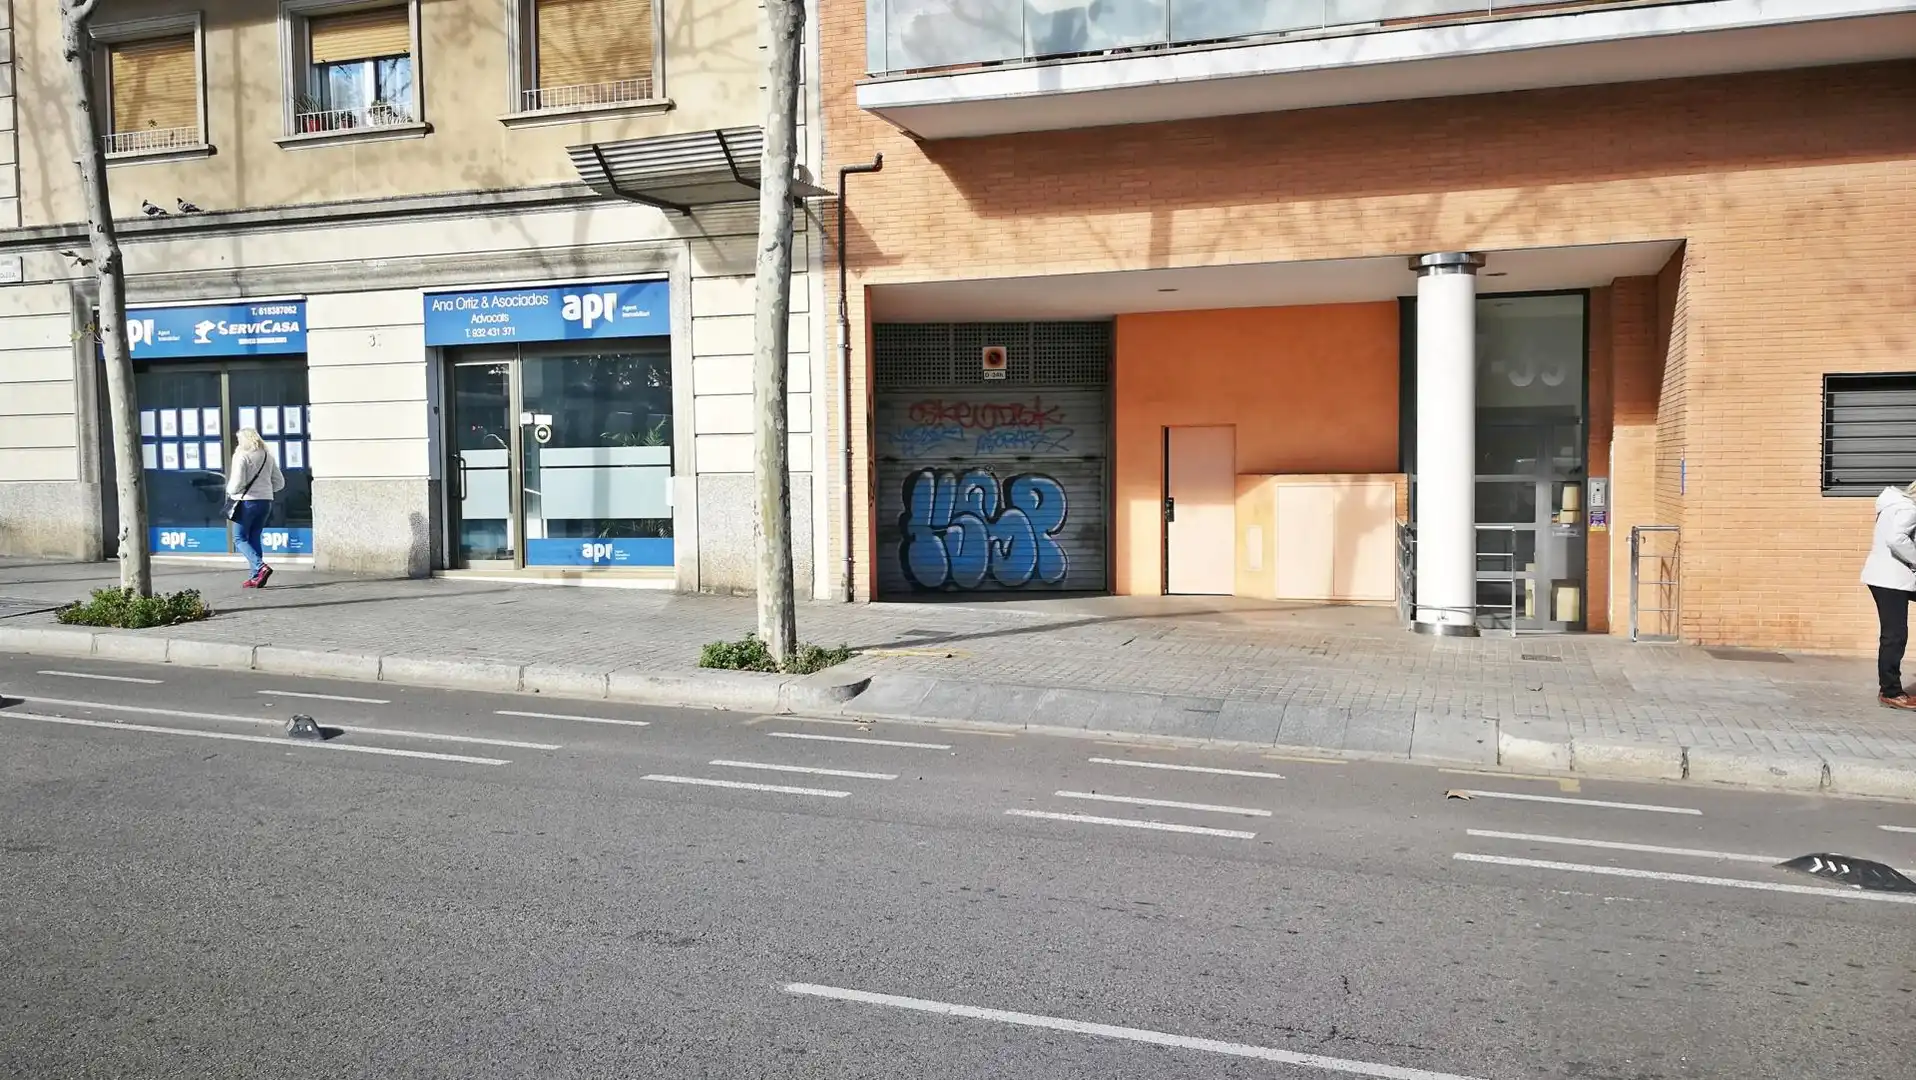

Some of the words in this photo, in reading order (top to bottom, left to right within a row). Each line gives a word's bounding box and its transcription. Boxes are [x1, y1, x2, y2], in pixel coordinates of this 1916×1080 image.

[432, 299, 453, 312] Ana
[455, 296, 480, 310] Ortiz
[481, 295, 489, 309] &
[491, 293, 549, 308] Asociados
[470, 312, 509, 324] Advocats
